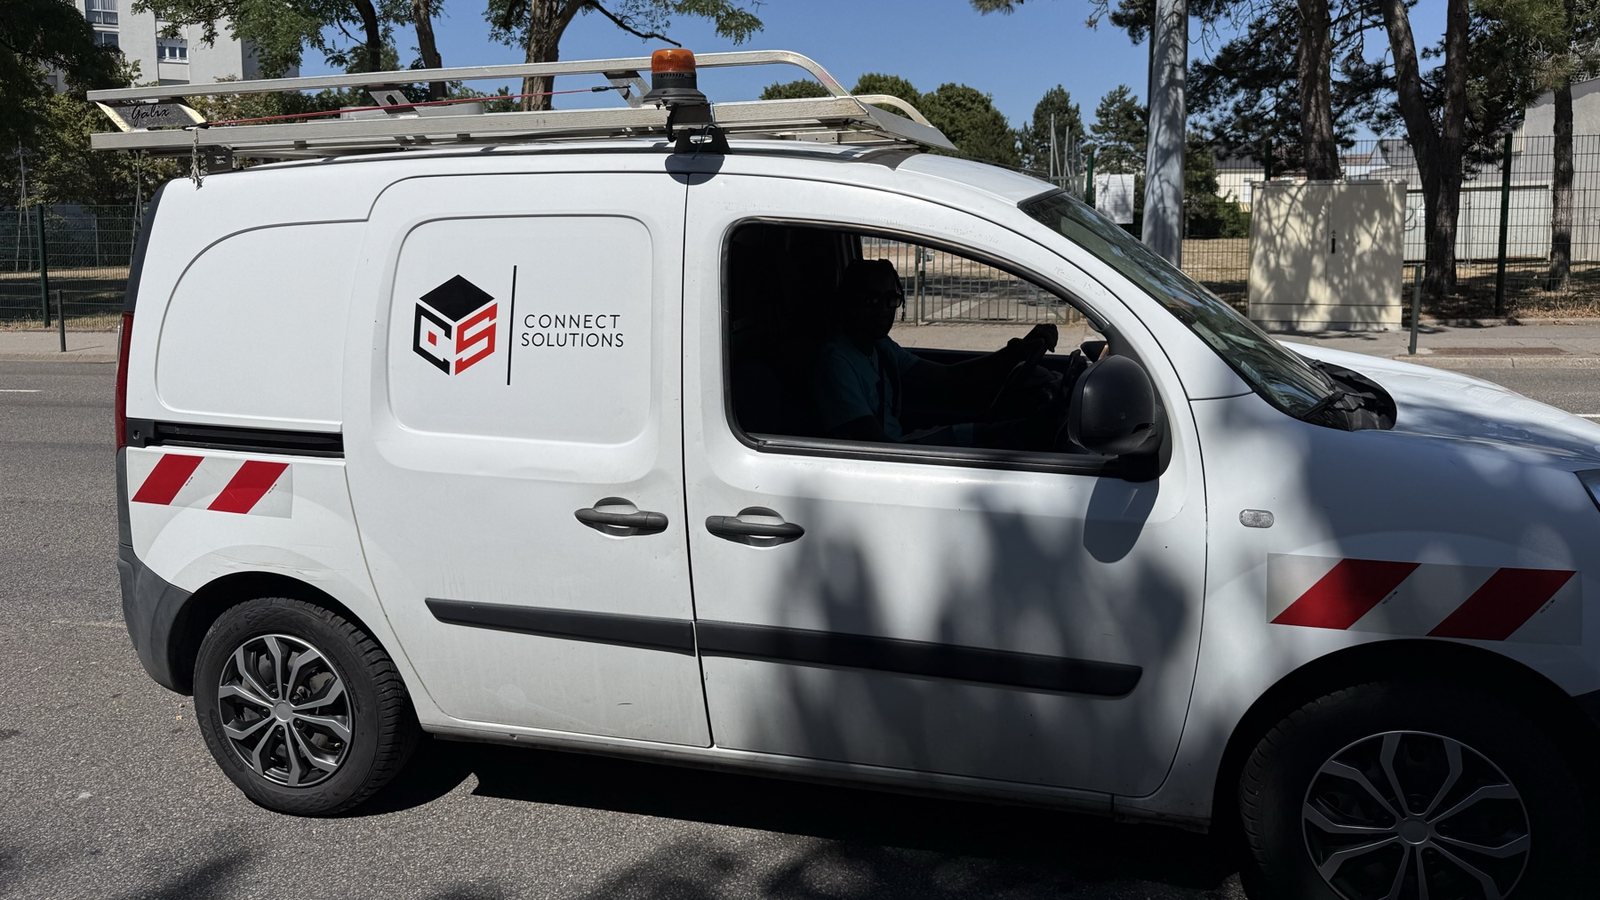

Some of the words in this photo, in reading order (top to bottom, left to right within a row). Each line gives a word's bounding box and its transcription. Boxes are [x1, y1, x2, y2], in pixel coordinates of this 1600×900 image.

[131, 104, 170, 127] Galix
[524, 314, 621, 329] CONNECT
[521, 332, 624, 348] SOLUTIONS
